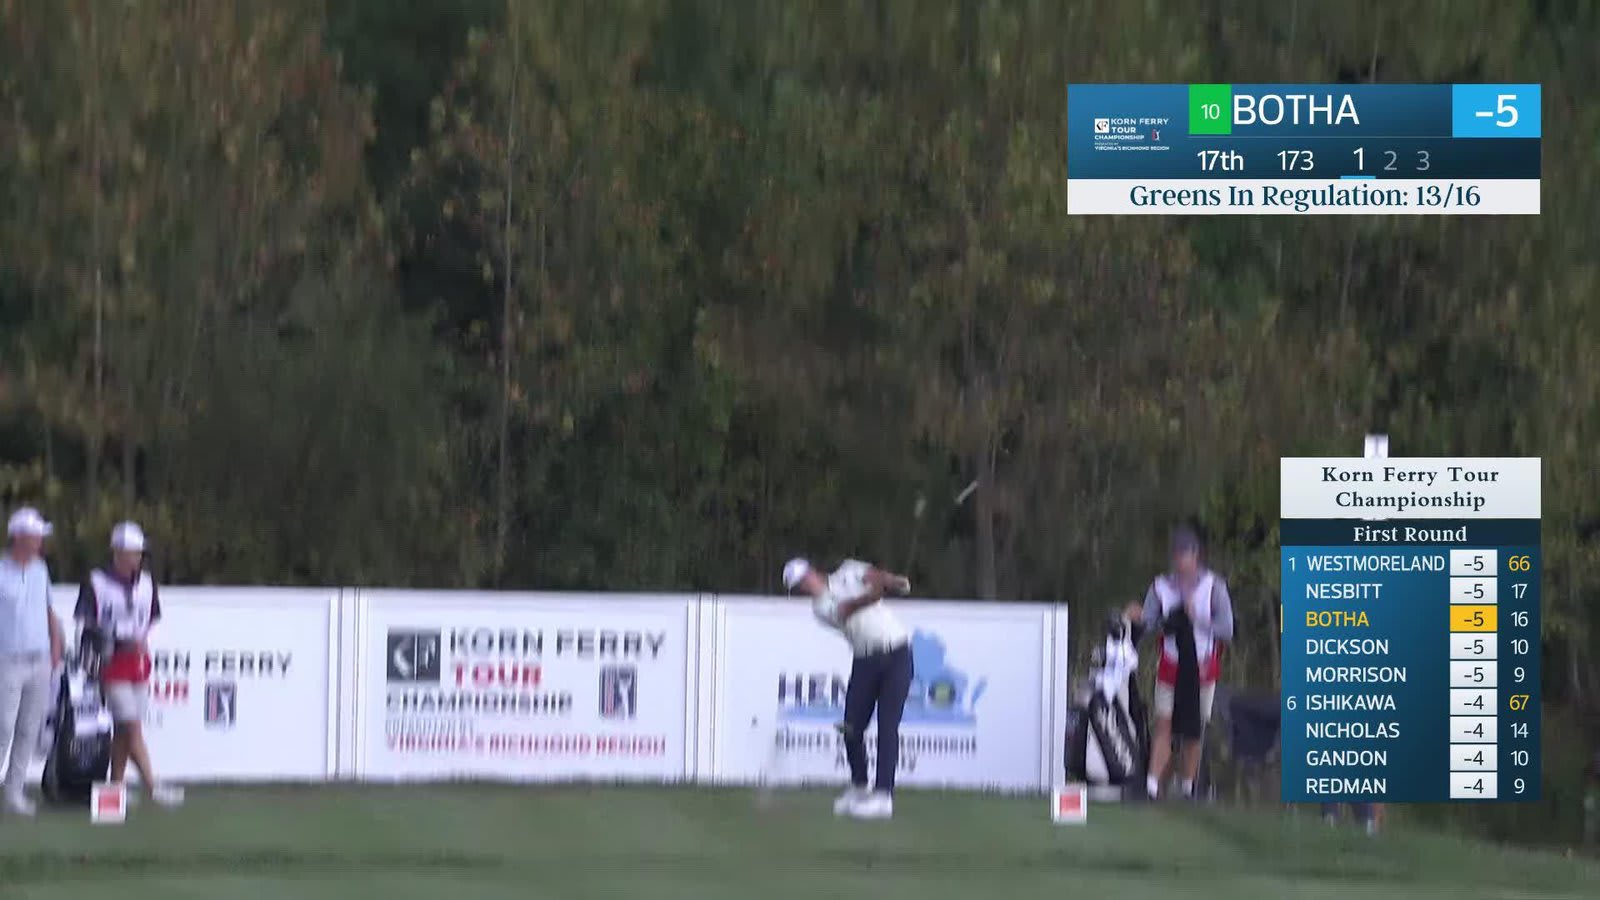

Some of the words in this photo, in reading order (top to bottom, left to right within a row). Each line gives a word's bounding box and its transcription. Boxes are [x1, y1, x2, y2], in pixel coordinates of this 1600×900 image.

[451, 629, 543, 657] KORN
[555, 629, 666, 658] FERRY
[205, 651, 292, 676] FERRY
[453, 662, 542, 686] TOUR
